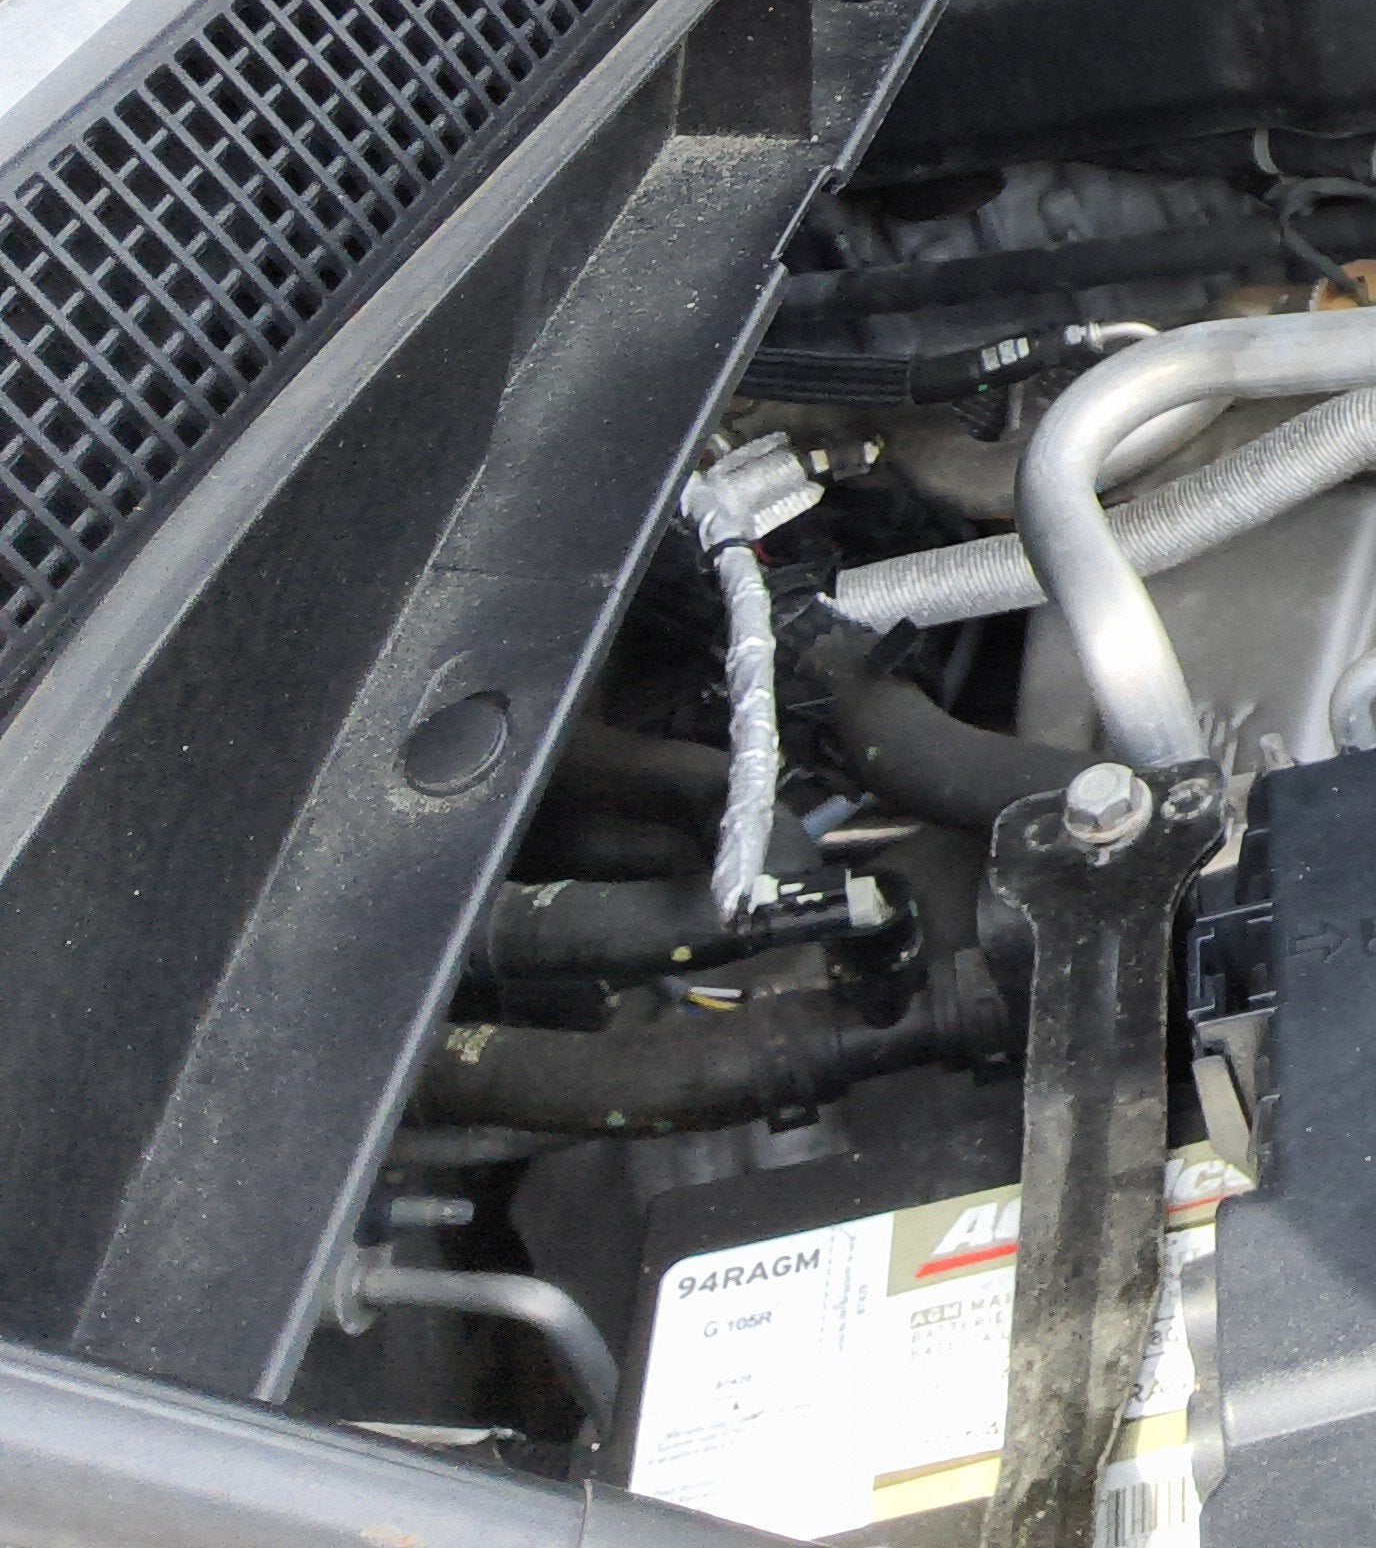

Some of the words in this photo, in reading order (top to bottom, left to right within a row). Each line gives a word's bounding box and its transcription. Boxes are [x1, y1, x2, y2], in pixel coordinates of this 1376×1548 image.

[677, 1248, 822, 1300] 94RAGM
[703, 1319, 719, 1339] G
[727, 1309, 773, 1333] 105R
